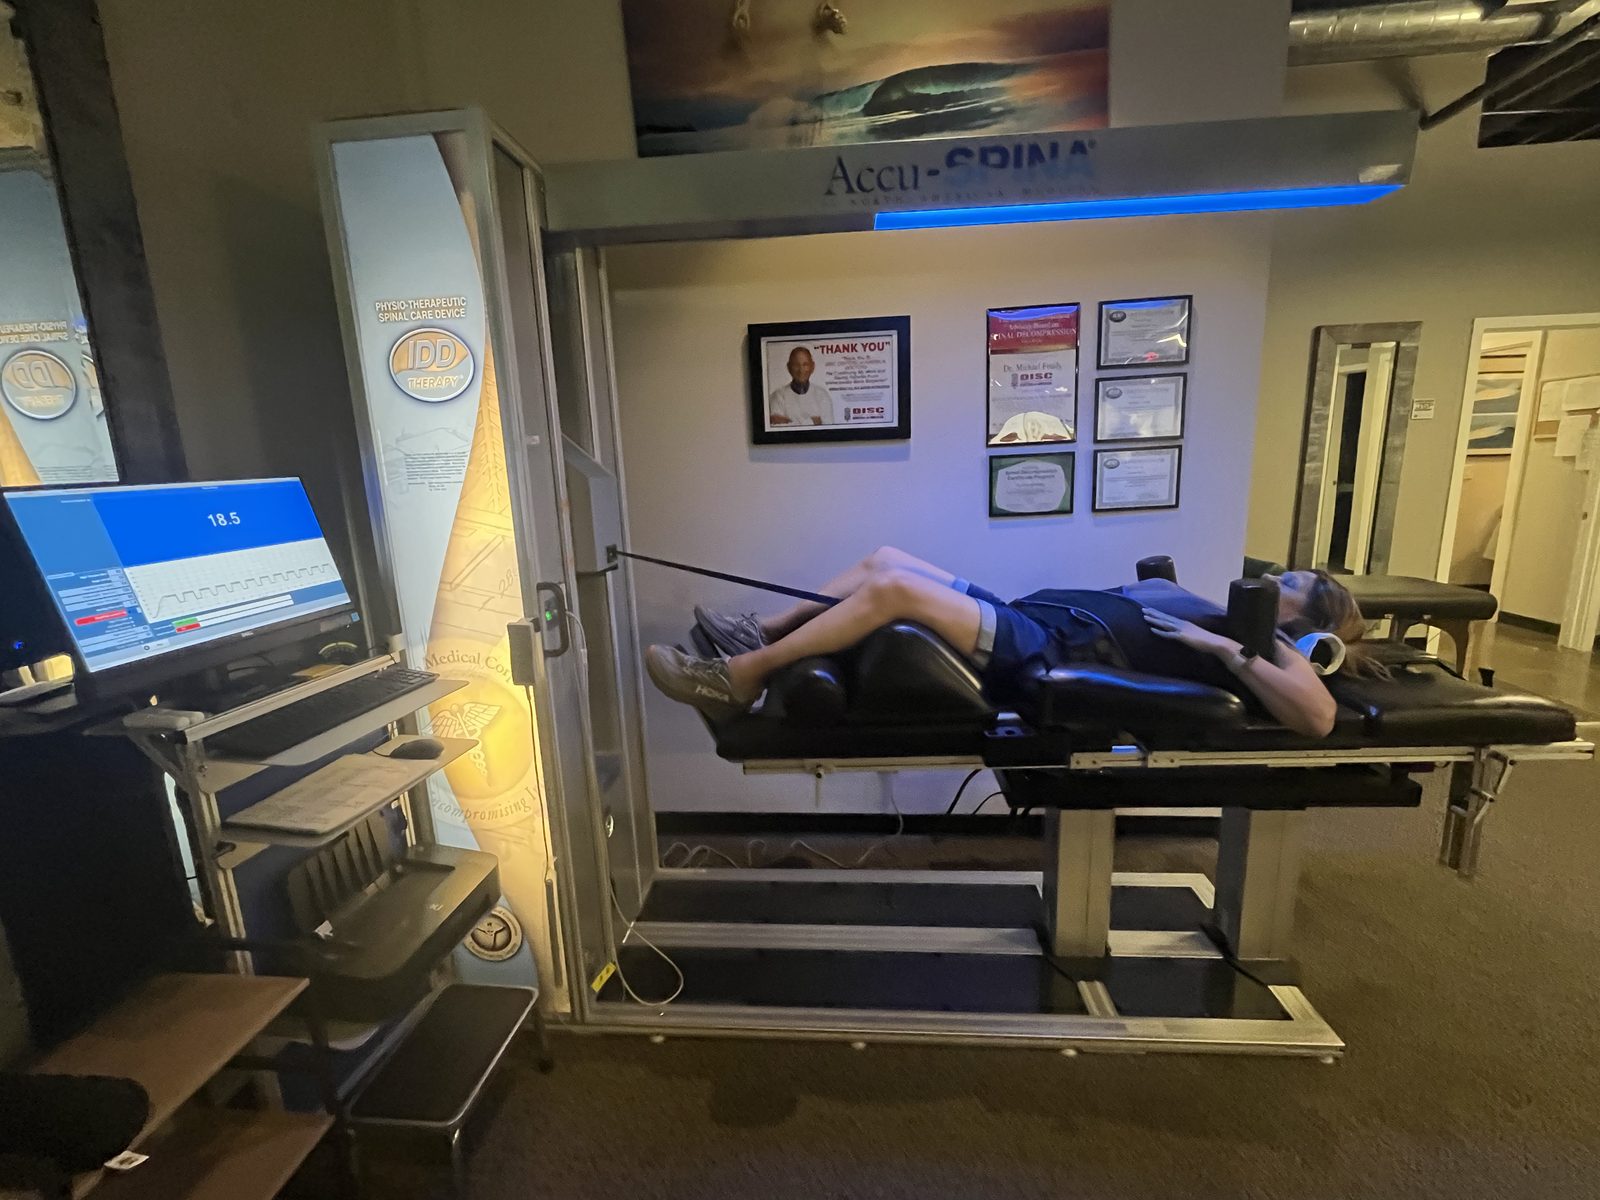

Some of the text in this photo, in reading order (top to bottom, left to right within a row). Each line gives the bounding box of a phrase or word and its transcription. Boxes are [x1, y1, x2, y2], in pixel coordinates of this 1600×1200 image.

[375, 297, 466, 311] PHYSIO-THERAPEUTIC
[378, 308, 466, 322] SPINAL CARE DEVICE
[407, 338, 457, 370] IDD
[407, 375, 458, 390] THERAPY
[207, 511, 241, 527] 18.5
[424, 649, 481, 670] Medical
